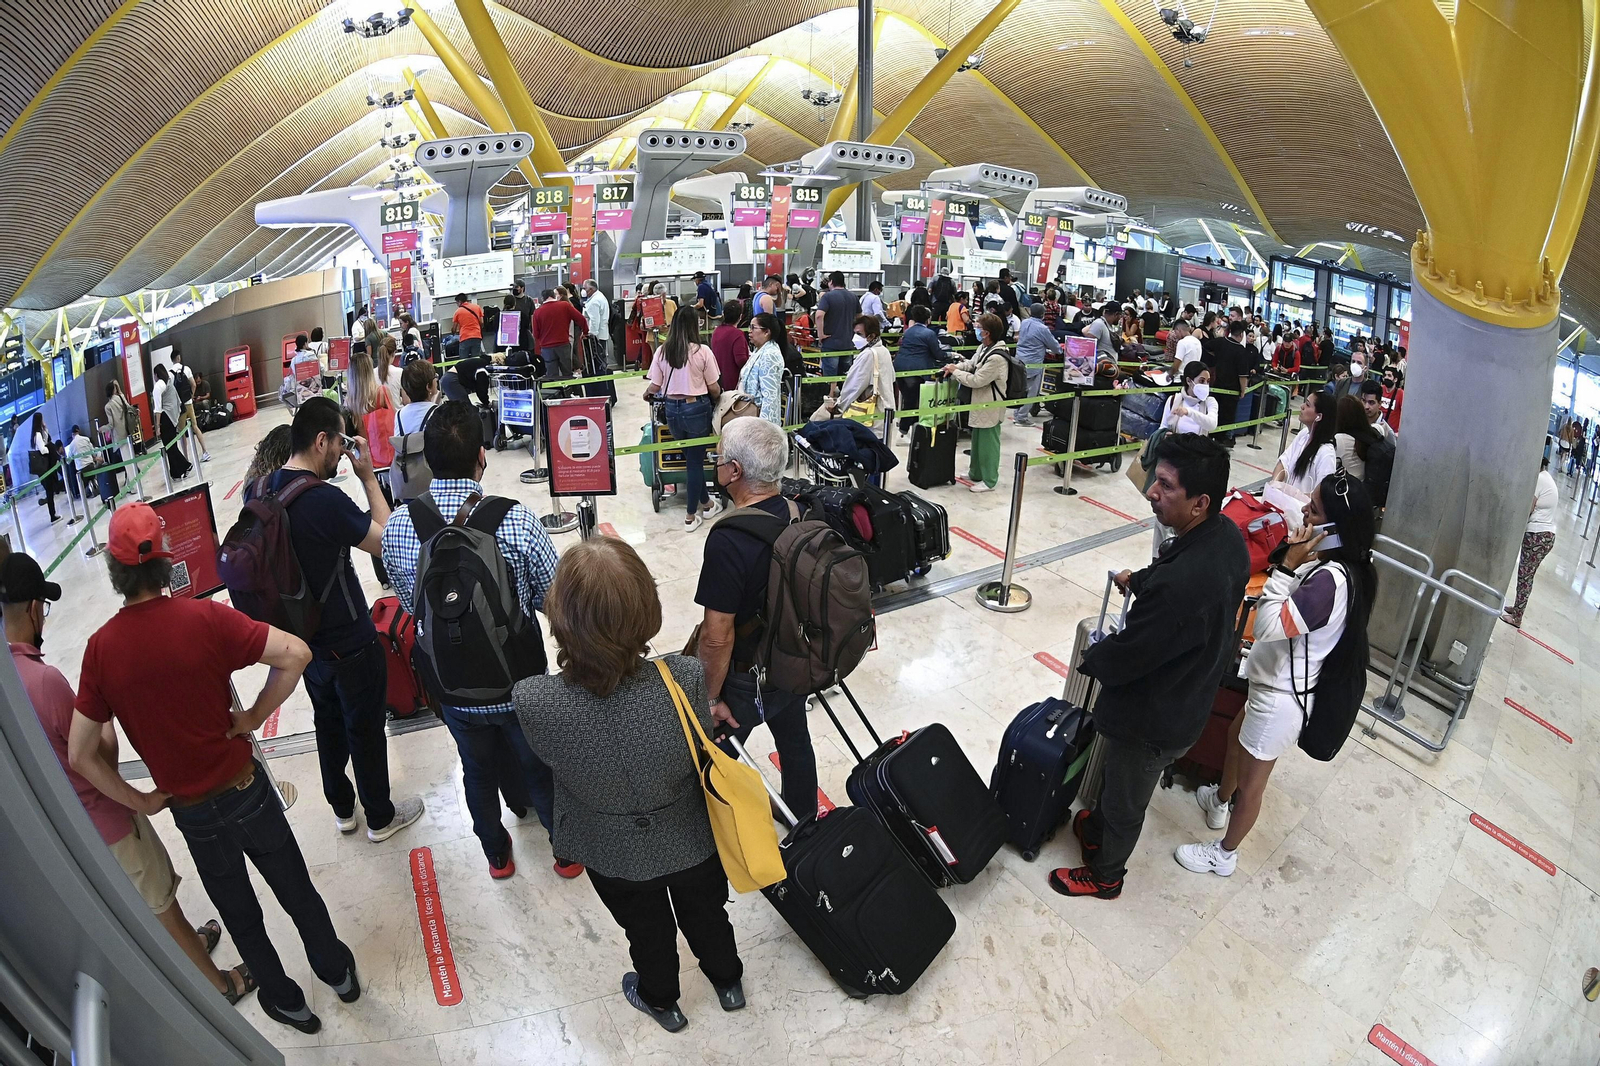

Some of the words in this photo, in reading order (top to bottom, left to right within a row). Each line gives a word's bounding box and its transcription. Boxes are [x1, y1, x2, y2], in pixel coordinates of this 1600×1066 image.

[535, 190, 563, 205] 818
[602, 186, 629, 201] 817
[740, 186, 765, 200] 816
[796, 188, 819, 202] 815
[906, 197, 925, 211] 814
[948, 202, 966, 215] 813
[385, 204, 413, 222] 819
[1028, 214, 1043, 226] 812
[1059, 219, 1072, 231] 811
[123, 331, 130, 339] IB
[184, 495, 198, 503] IBERIA
[1474, 817, 1492, 832] Mantén
[1496, 832, 1517, 848] distancia
[417, 852, 428, 880] distance
[421, 880, 430, 897] your
[425, 896, 434, 916] Keep
[427, 919, 443, 955] distancia
[435, 955, 444, 965] la
[438, 965, 453, 998] Mantén
[1375, 1031, 1399, 1053] Mantén
[1405, 1052, 1425, 1066] distan
